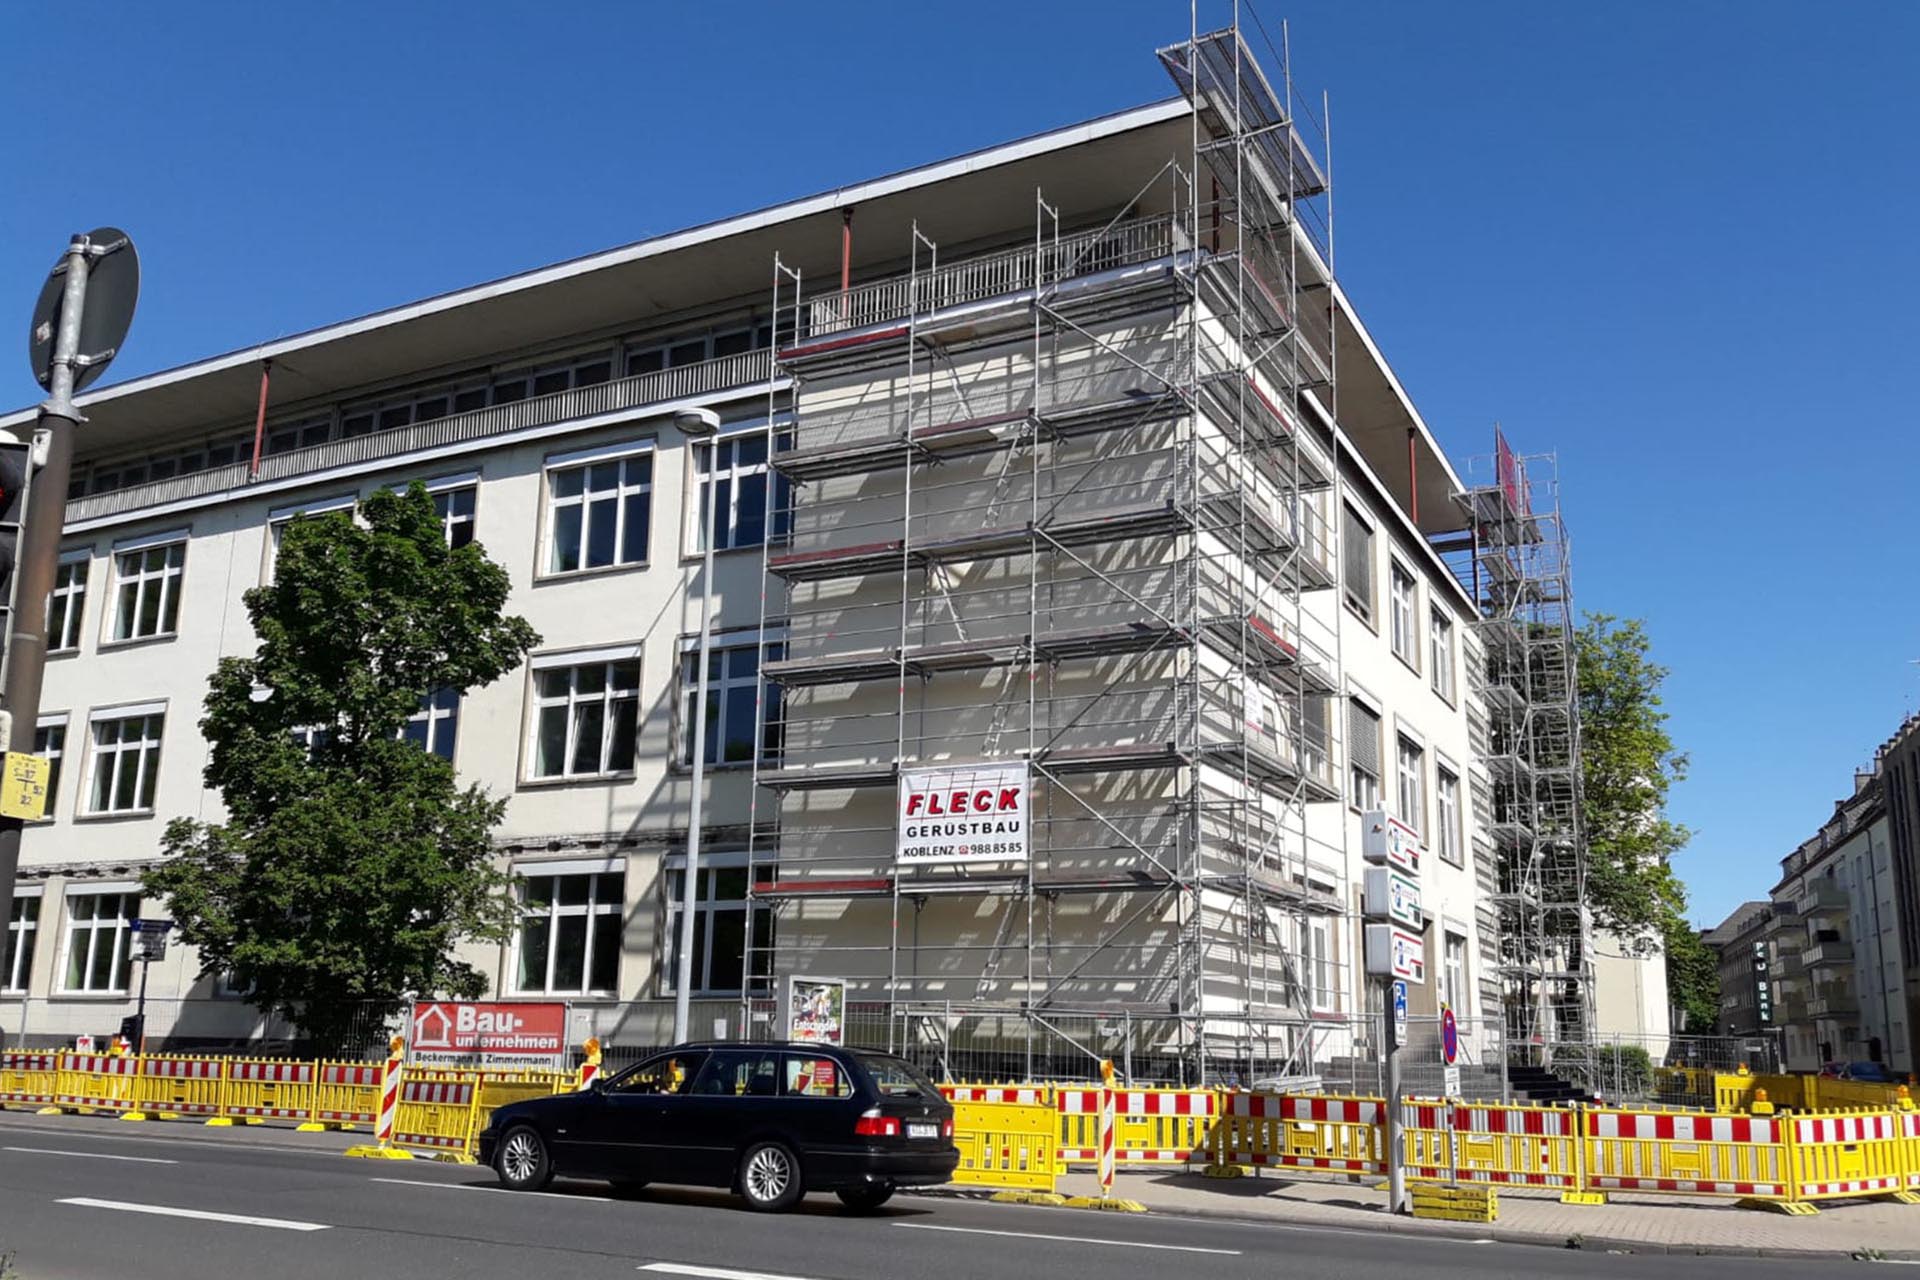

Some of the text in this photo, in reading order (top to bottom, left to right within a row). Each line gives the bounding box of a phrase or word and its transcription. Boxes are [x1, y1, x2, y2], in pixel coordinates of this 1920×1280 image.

[906, 788, 1020, 815] FLECK
[906, 821, 1020, 838] GERÜSTBAU
[903, 845, 955, 857] KOBLENZ
[1758, 982, 1769, 1021] Bank
[456, 1006, 524, 1033] Bau-
[456, 1035, 558, 1049] unternehmen
[415, 1052, 474, 1064] Beckermann
[486, 1055, 551, 1065] Zimmermann
